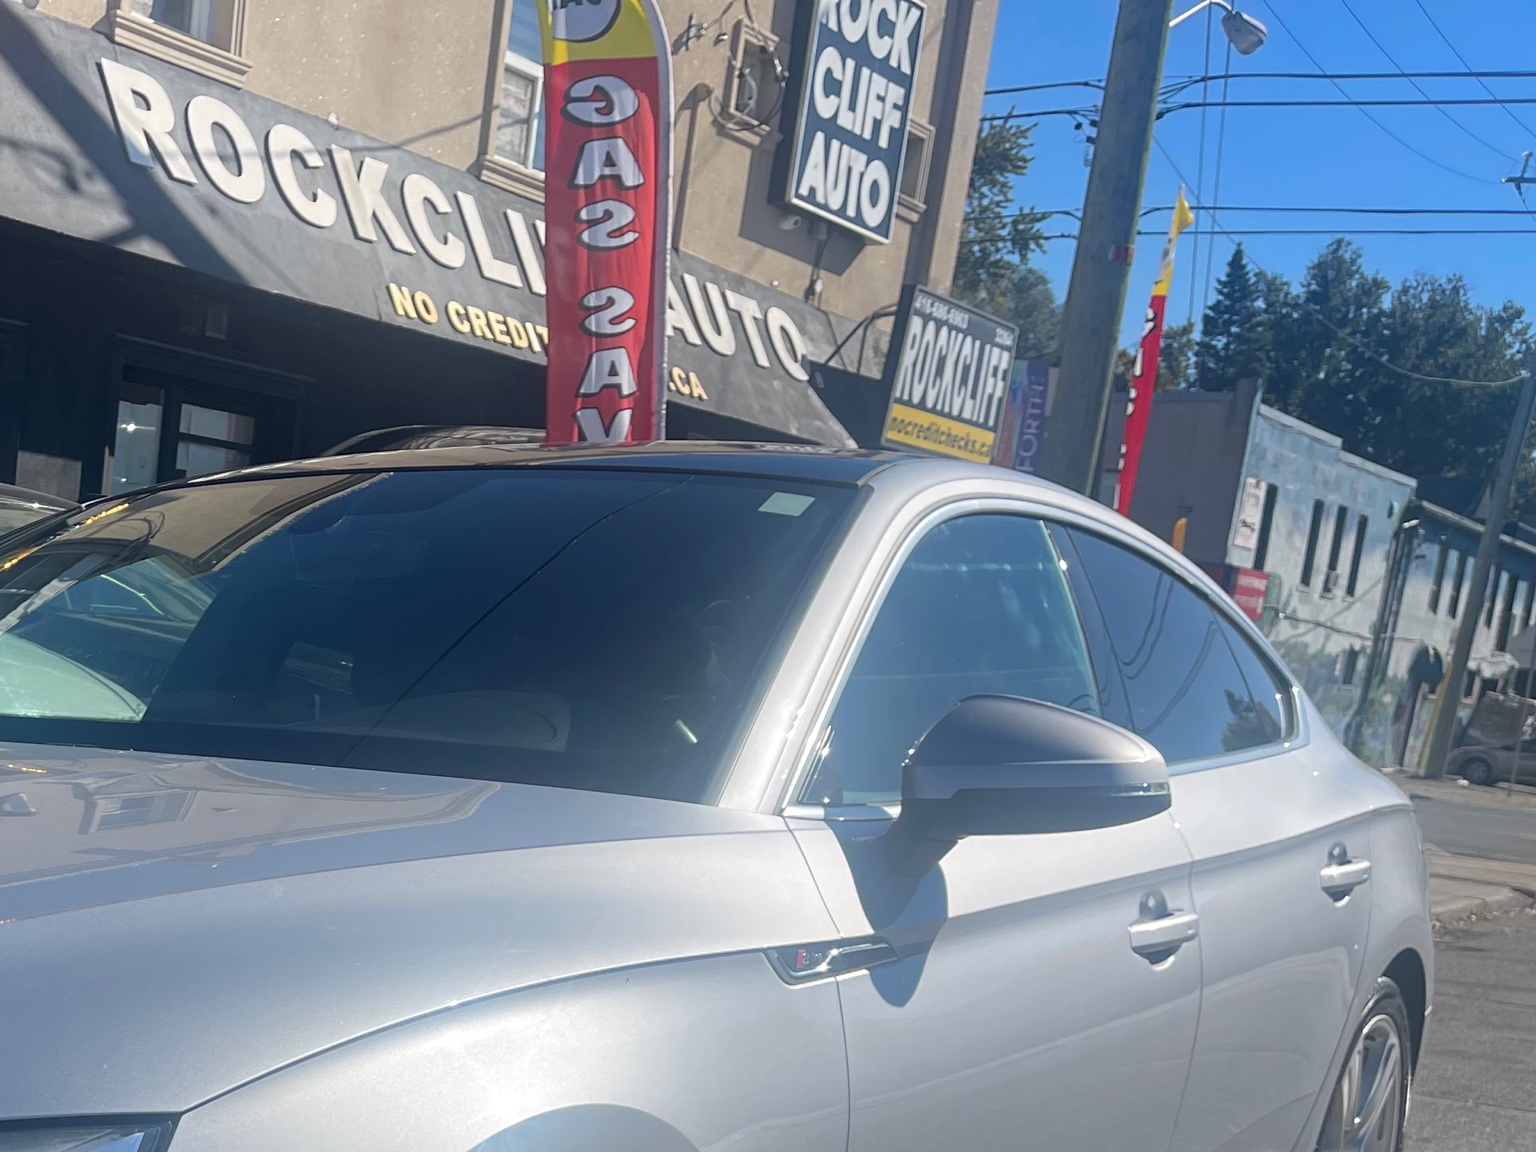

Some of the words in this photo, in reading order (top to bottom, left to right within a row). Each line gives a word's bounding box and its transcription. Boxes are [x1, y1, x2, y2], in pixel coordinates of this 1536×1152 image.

[814, 46, 905, 149] CLIFF
[101, 57, 547, 296] ROCKCLI
[666, 272, 810, 381] AUTO
[798, 130, 891, 228] AUTO
[388, 282, 439, 324] NO
[895, 315, 1011, 427] ROCKCLIFF
